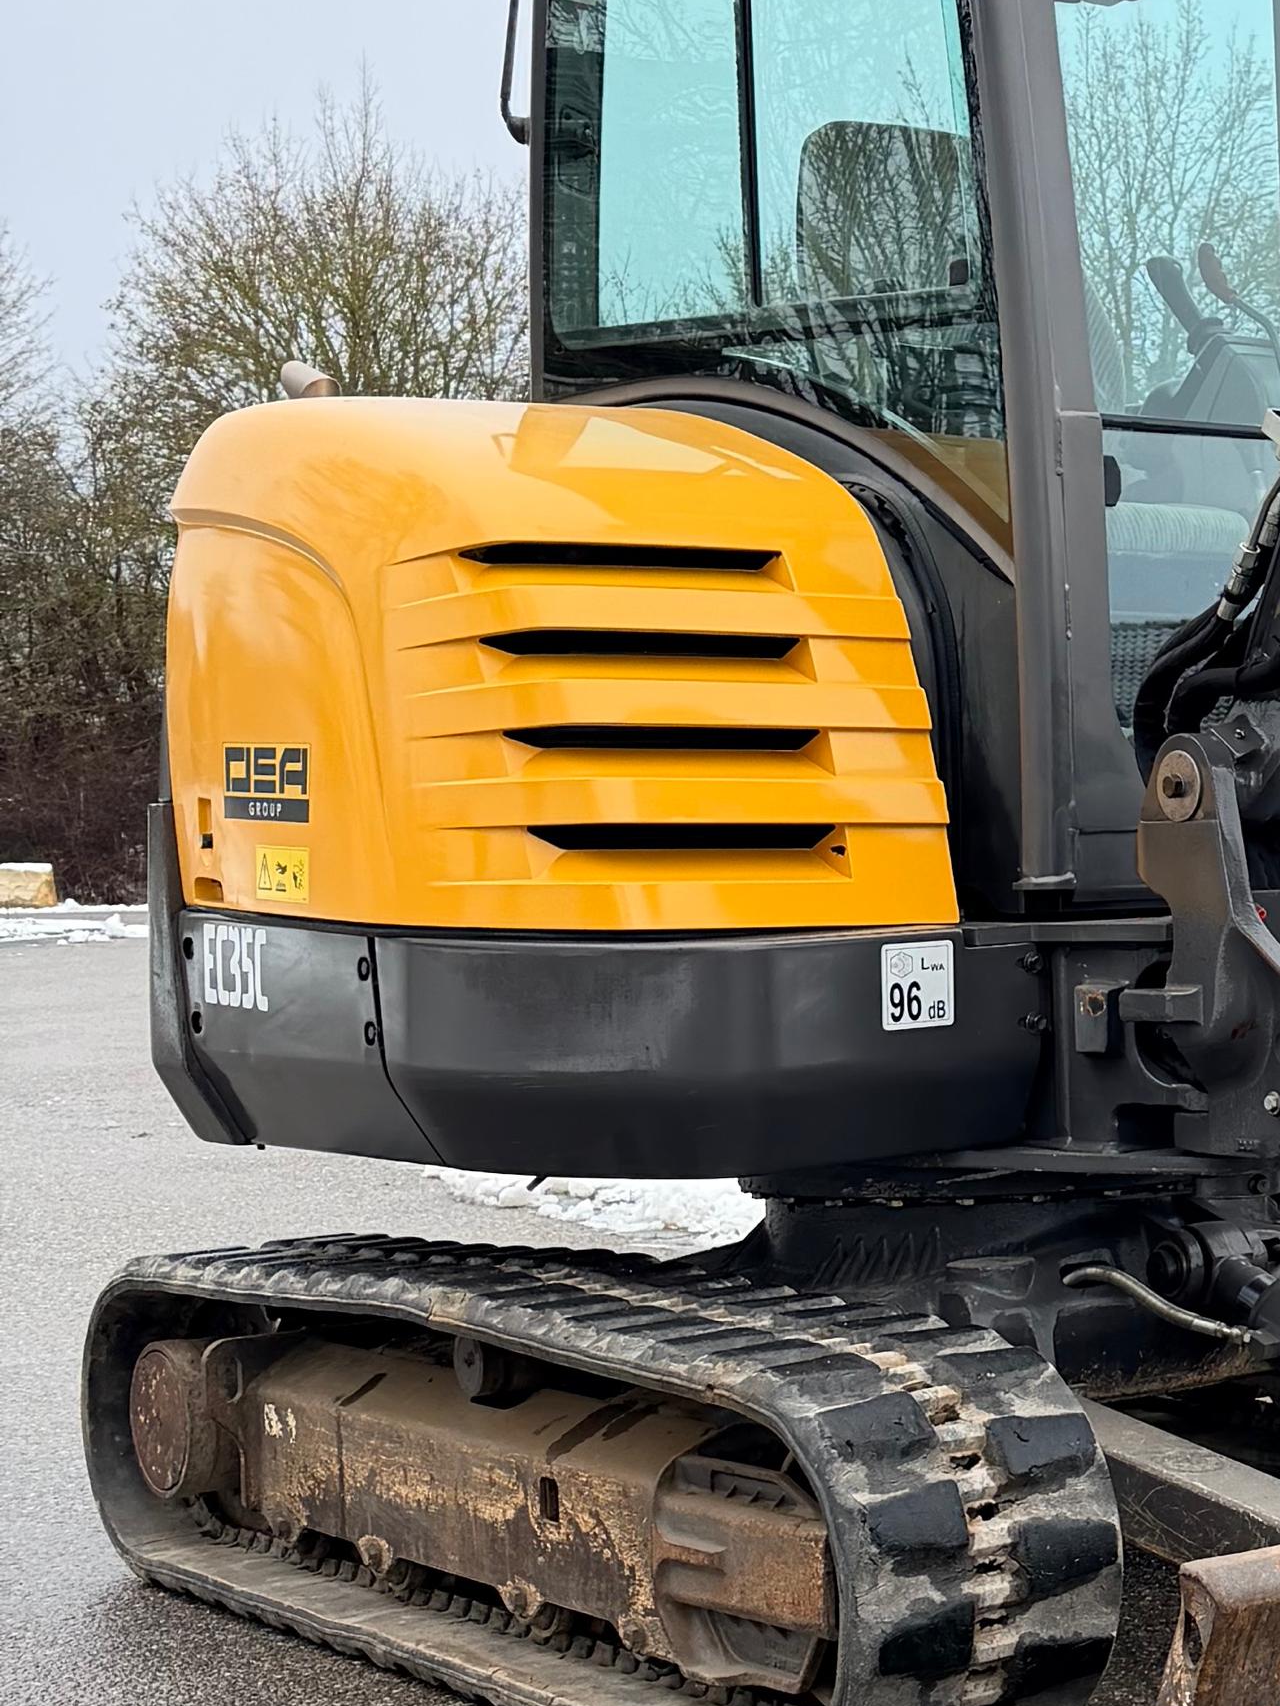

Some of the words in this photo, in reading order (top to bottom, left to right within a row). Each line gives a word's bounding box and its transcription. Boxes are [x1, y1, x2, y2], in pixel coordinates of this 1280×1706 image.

[248, 801, 283, 818] GROUP
[203, 923, 268, 1011] EC35C
[889, 980, 922, 1023] 96
[928, 1000, 946, 1019] dB
